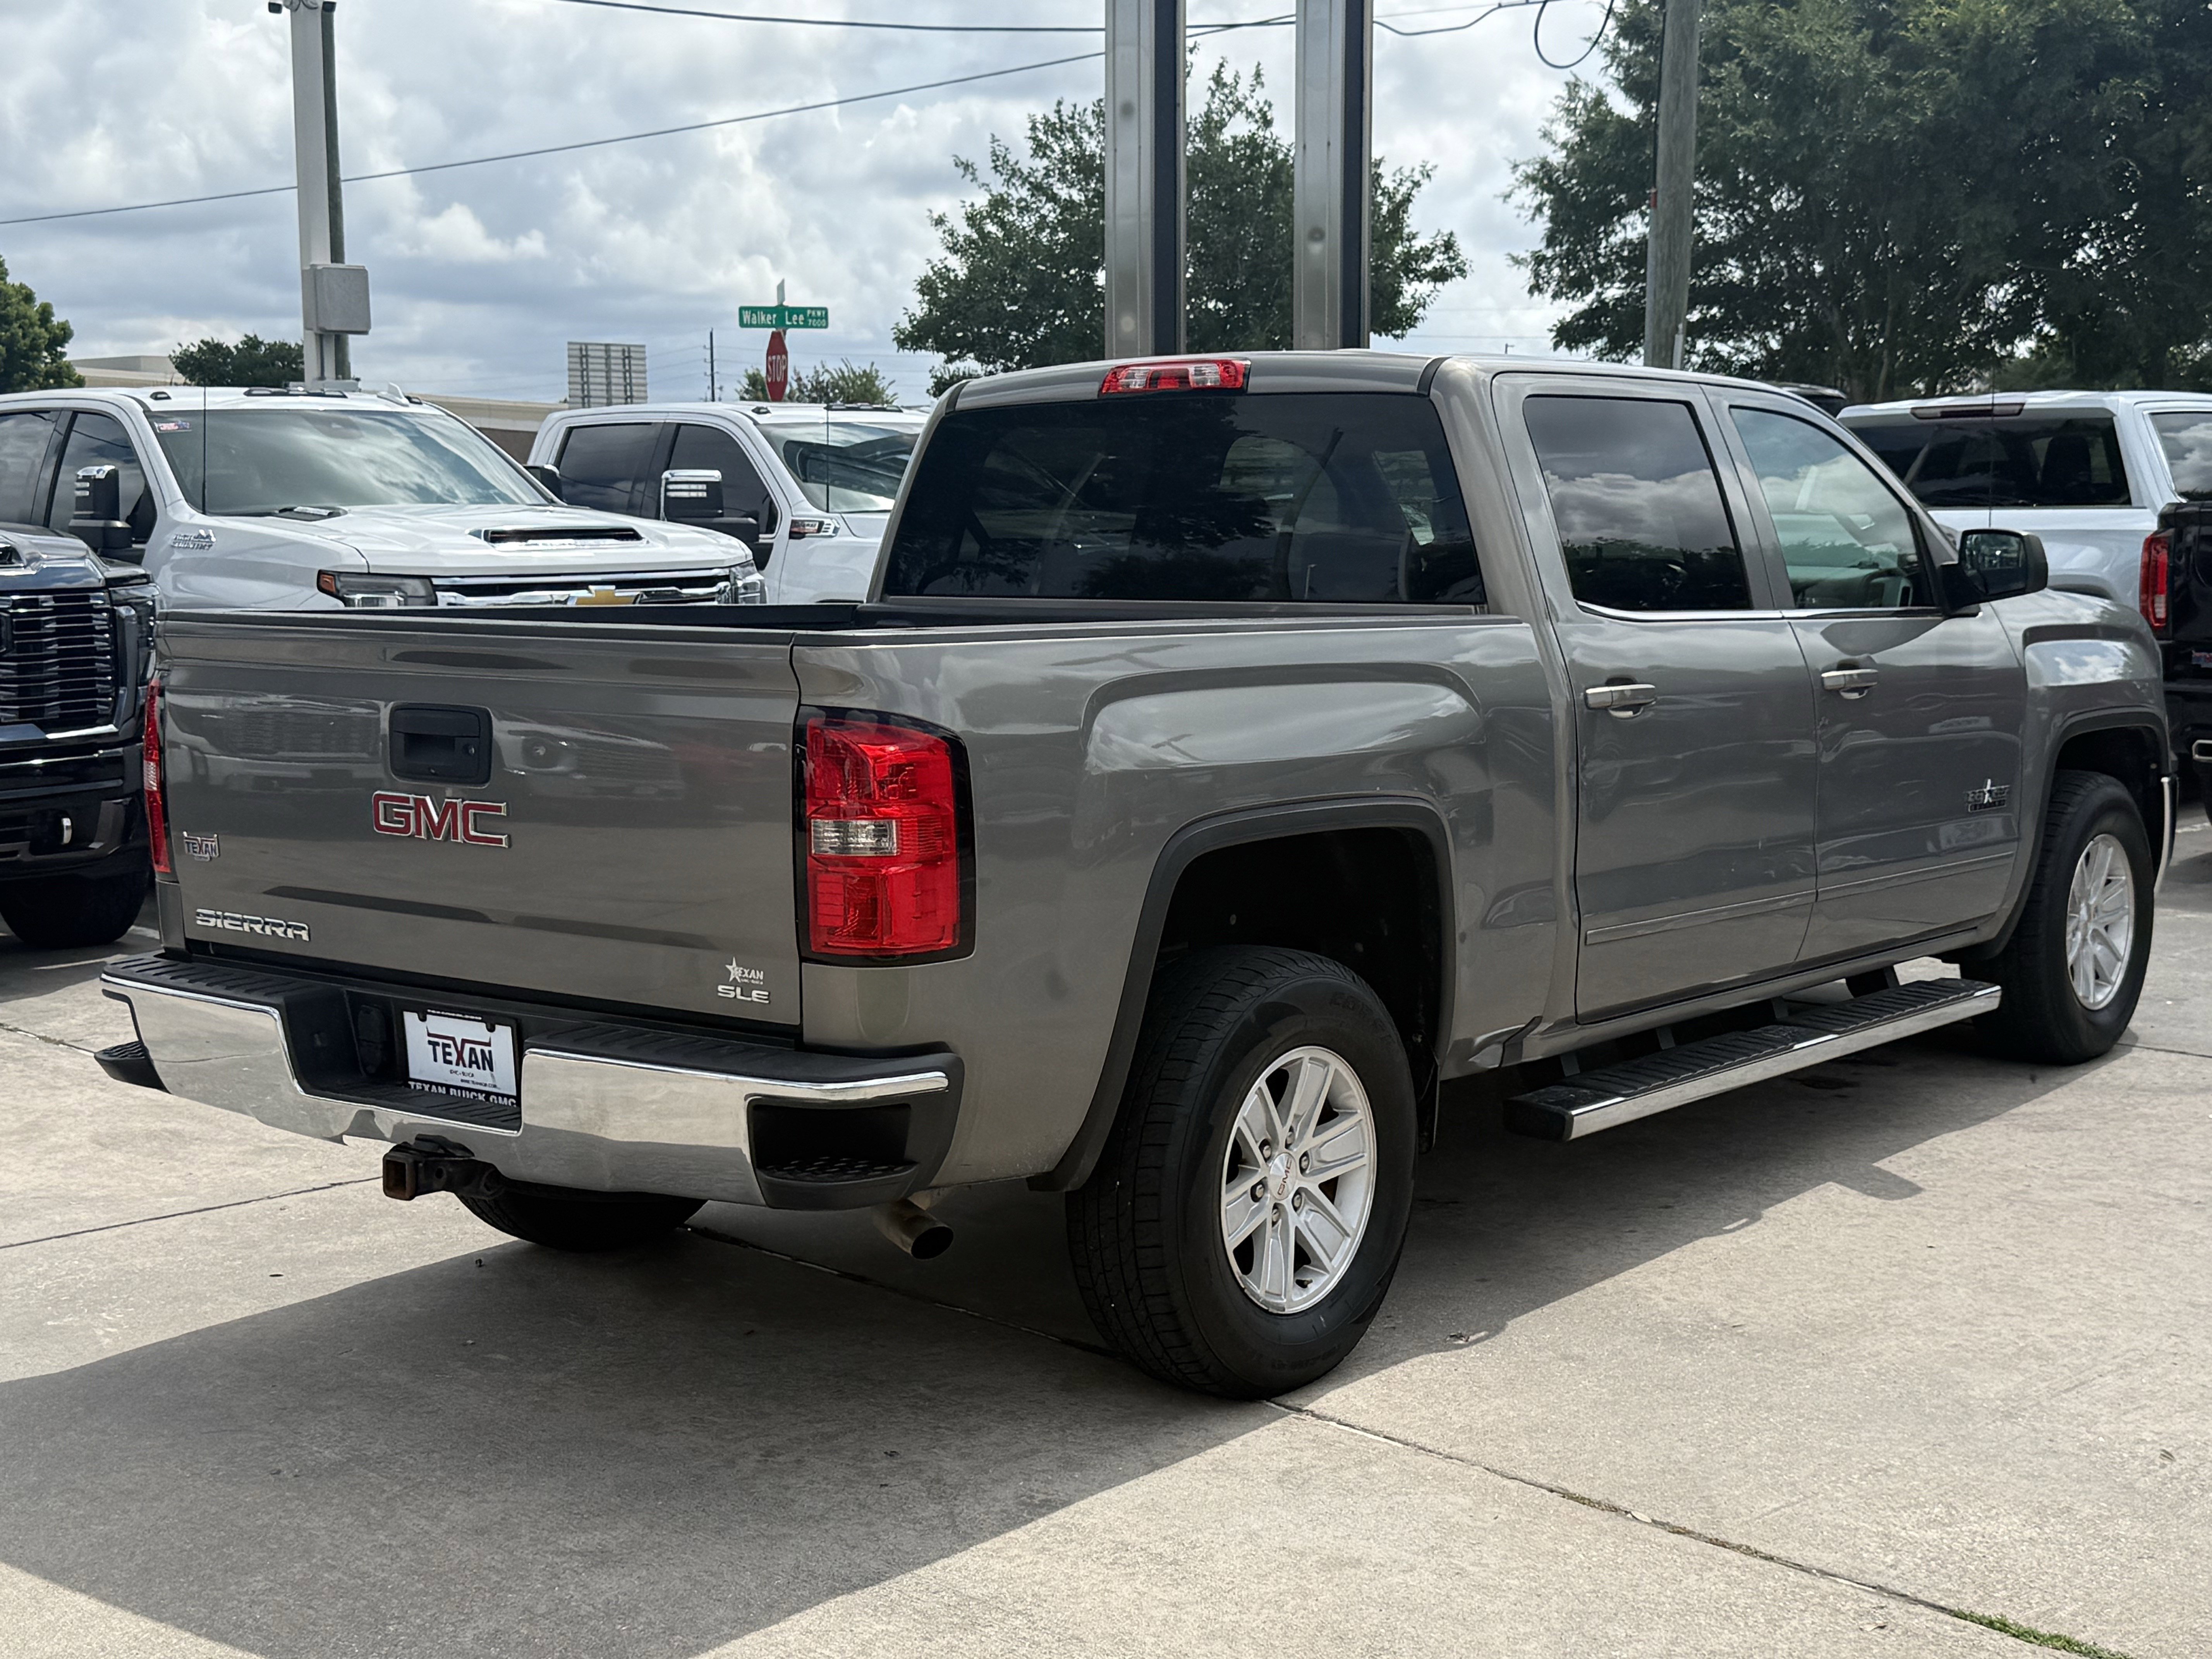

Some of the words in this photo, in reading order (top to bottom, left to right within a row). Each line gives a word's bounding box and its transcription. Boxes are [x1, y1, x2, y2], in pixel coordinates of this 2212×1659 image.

[743, 310, 776, 325] Walker
[785, 311, 804, 325] Lee
[768, 354, 787, 382] STOP
[373, 790, 508, 848] GMC
[185, 836, 218, 857] TEXAN
[196, 908, 309, 941] SIERRA
[718, 984, 769, 1003] SLE
[427, 1033, 494, 1072] TEXAN
[408, 1081, 446, 1094] TEXAN
[449, 1087, 486, 1101] BUICK
[489, 1095, 517, 1108] GMC
[1277, 1156, 1292, 1195] GMC
